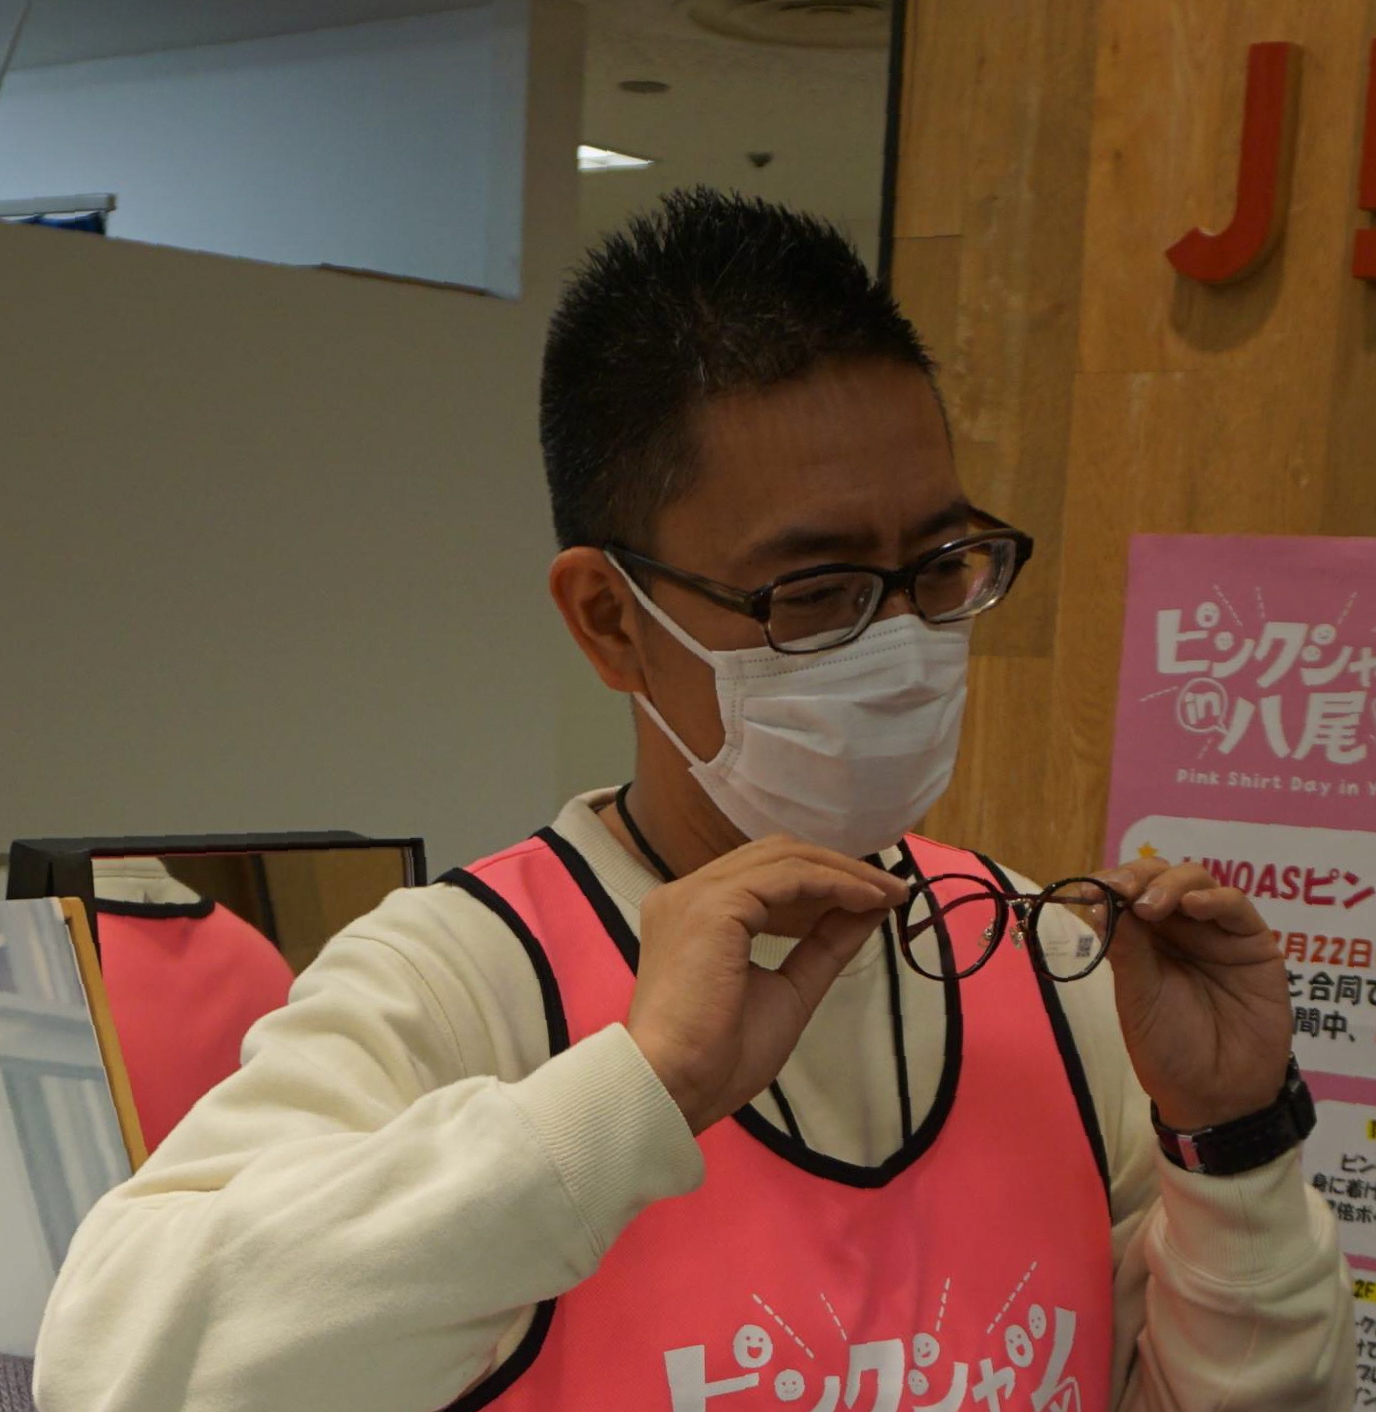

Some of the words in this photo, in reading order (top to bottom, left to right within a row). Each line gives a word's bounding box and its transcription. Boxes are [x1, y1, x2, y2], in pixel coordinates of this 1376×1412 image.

[1219, 690, 1368, 766] 八尾
[1228, 771, 1282, 790] Shirt
[1290, 776, 1332, 797] Day
[1339, 779, 1359, 795] in
